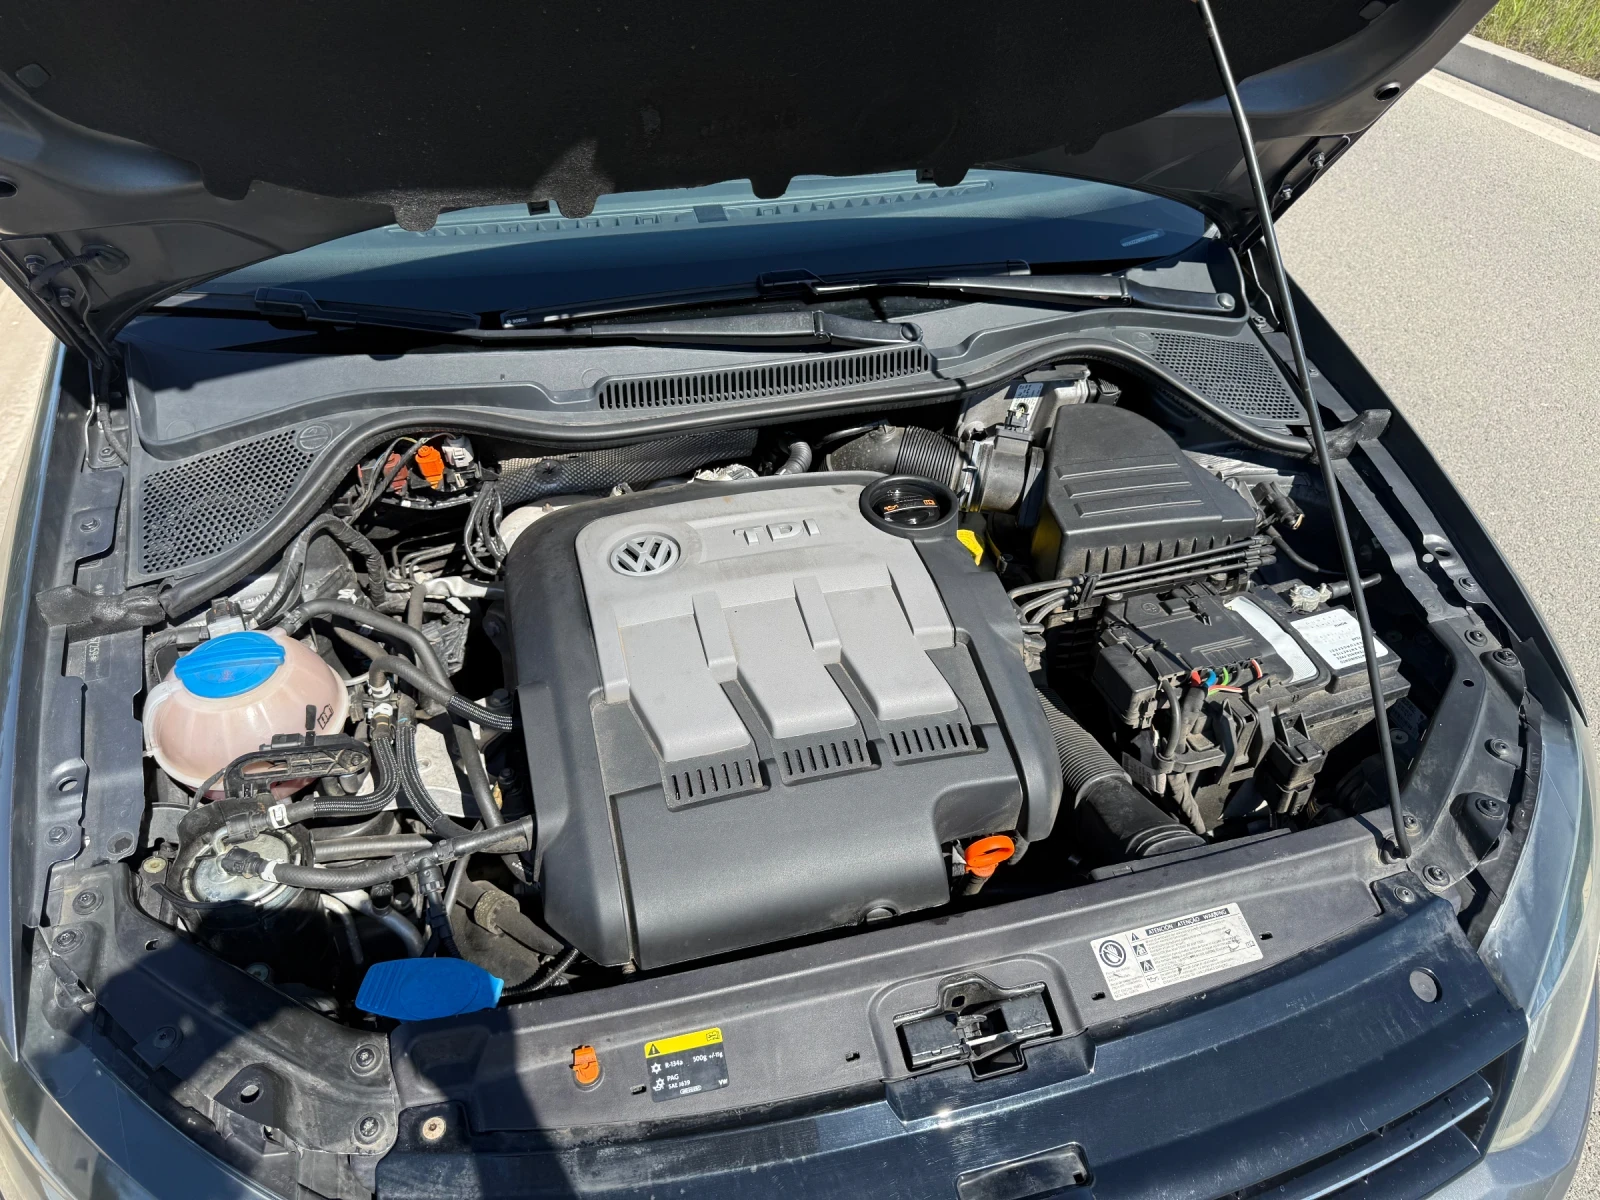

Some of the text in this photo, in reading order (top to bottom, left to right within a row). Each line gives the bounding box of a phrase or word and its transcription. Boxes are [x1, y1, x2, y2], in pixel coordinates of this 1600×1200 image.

[733, 518, 821, 546] TDI
[610, 534, 679, 576] VW
[1177, 916, 1200, 927] ATENÇÃO
[1202, 909, 1227, 920] WARNING
[666, 1073, 679, 1081] PAG
